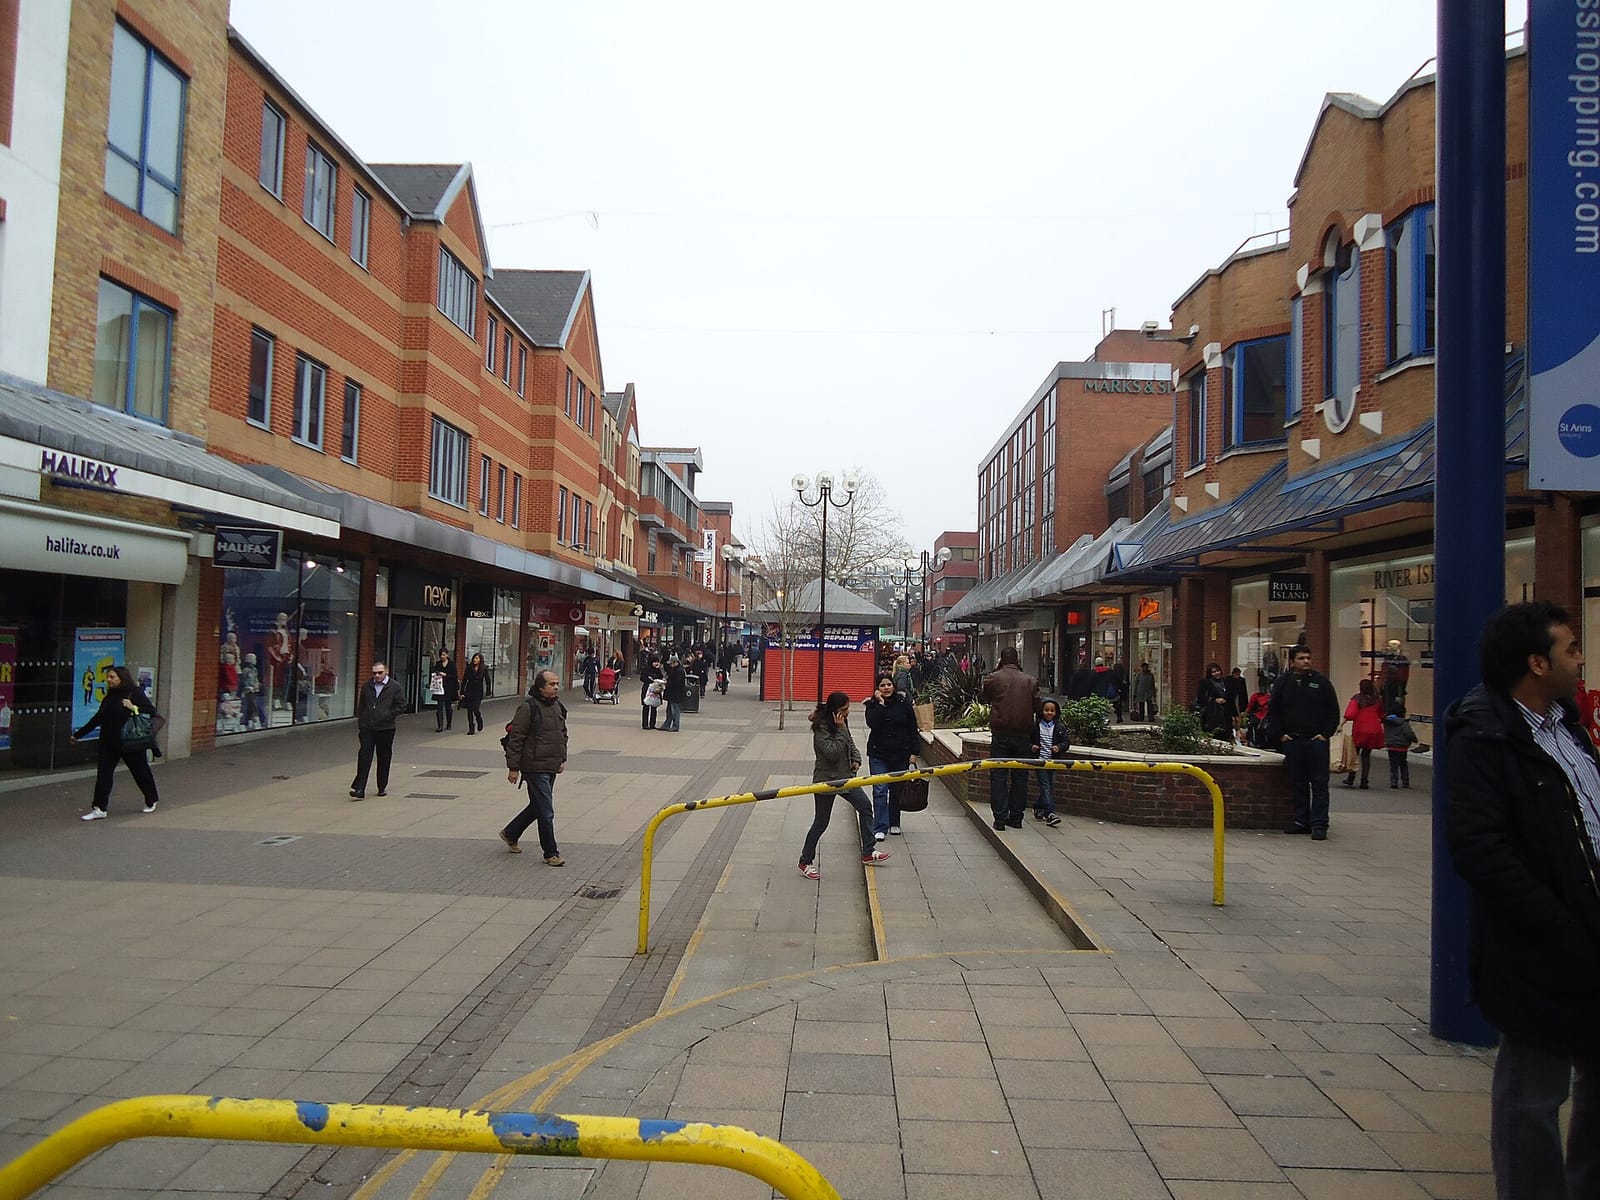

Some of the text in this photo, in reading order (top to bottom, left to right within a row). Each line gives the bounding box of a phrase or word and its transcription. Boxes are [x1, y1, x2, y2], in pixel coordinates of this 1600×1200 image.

[1084, 380, 1140, 393] MARKS
[1143, 381, 1155, 394] &
[1560, 423, 1592, 433] St Anns
[41, 450, 118, 486] HALIFAX
[46, 535, 120, 560] halifax.co.uk
[217, 542, 272, 555] HALIFAX
[1374, 568, 1412, 589] RIVER
[1273, 582, 1302, 591] RIVER
[424, 584, 451, 608] next
[1273, 591, 1310, 599] ISLAND
[470, 610, 491, 618] next
[633, 604, 644, 616] 3
[823, 627, 860, 635] SHOE
